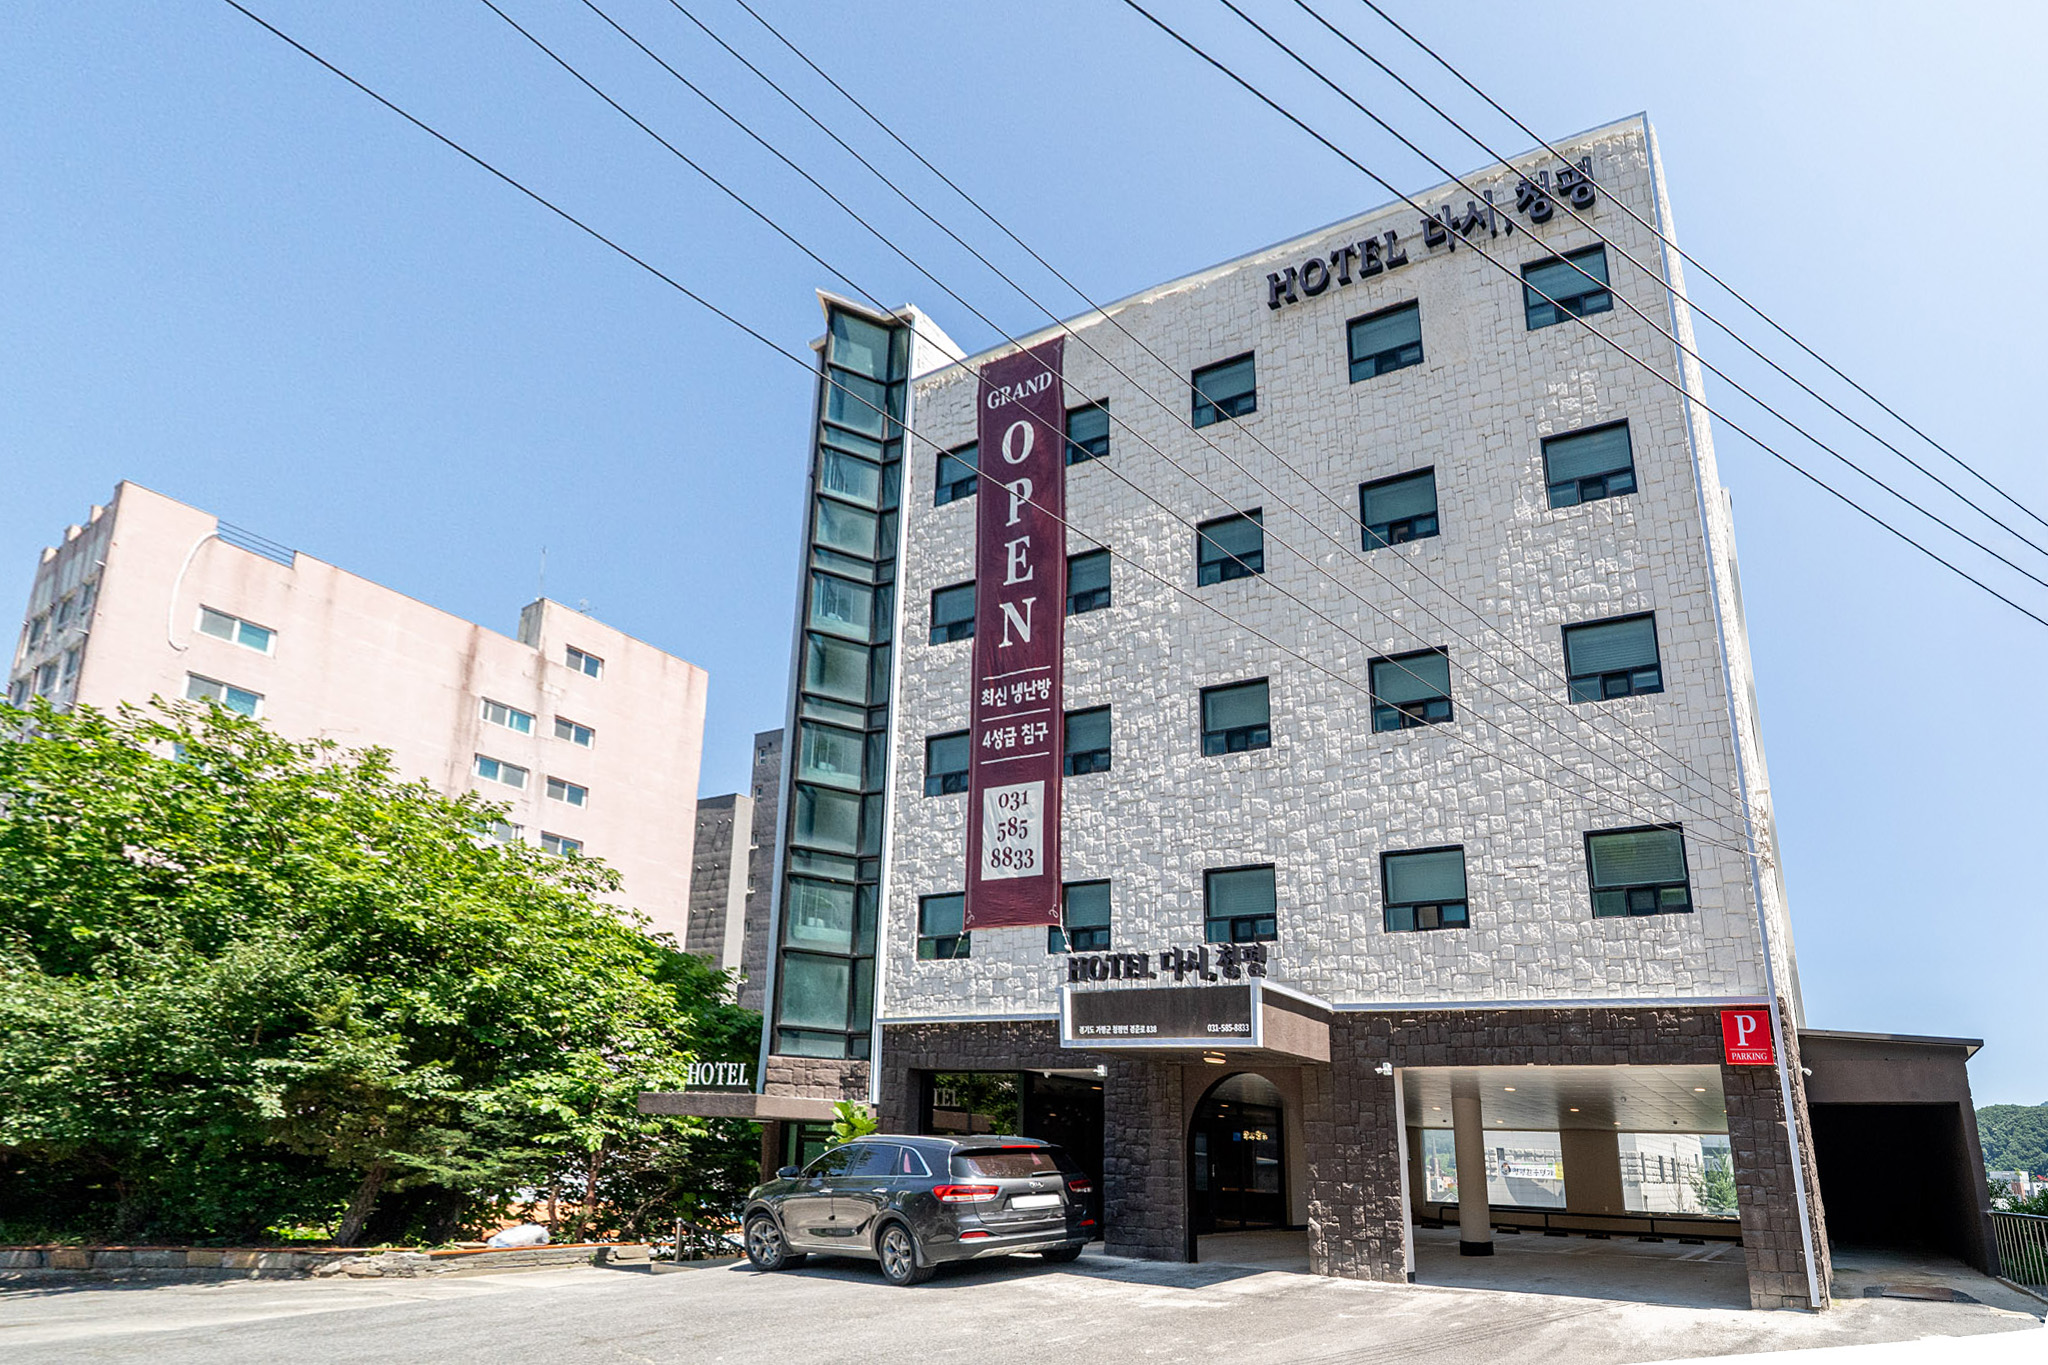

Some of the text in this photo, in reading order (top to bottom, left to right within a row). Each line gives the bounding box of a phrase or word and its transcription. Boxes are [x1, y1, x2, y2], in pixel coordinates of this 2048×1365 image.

[1266, 229, 1409, 310] HOTEL
[1514, 156, 1597, 224] 청평
[987, 371, 1053, 410] GRAND
[998, 419, 1037, 650] OPEN
[980, 677, 1052, 708] 최신 냉난방
[982, 721, 1049, 751] 4성급 침구
[998, 790, 1028, 811] 031
[997, 816, 1028, 843] 585
[991, 846, 1034, 870] 8833
[1216, 942, 1268, 980] 청평
[1079, 1025, 1095, 1034] 경기도
[1096, 1025, 1111, 1034] 가평군
[1207, 1023, 1249, 1032] 031-585-8833
[1734, 1014, 1757, 1046] P
[1731, 1052, 1768, 1060] PARKING
[686, 1061, 749, 1086] HOTEL
